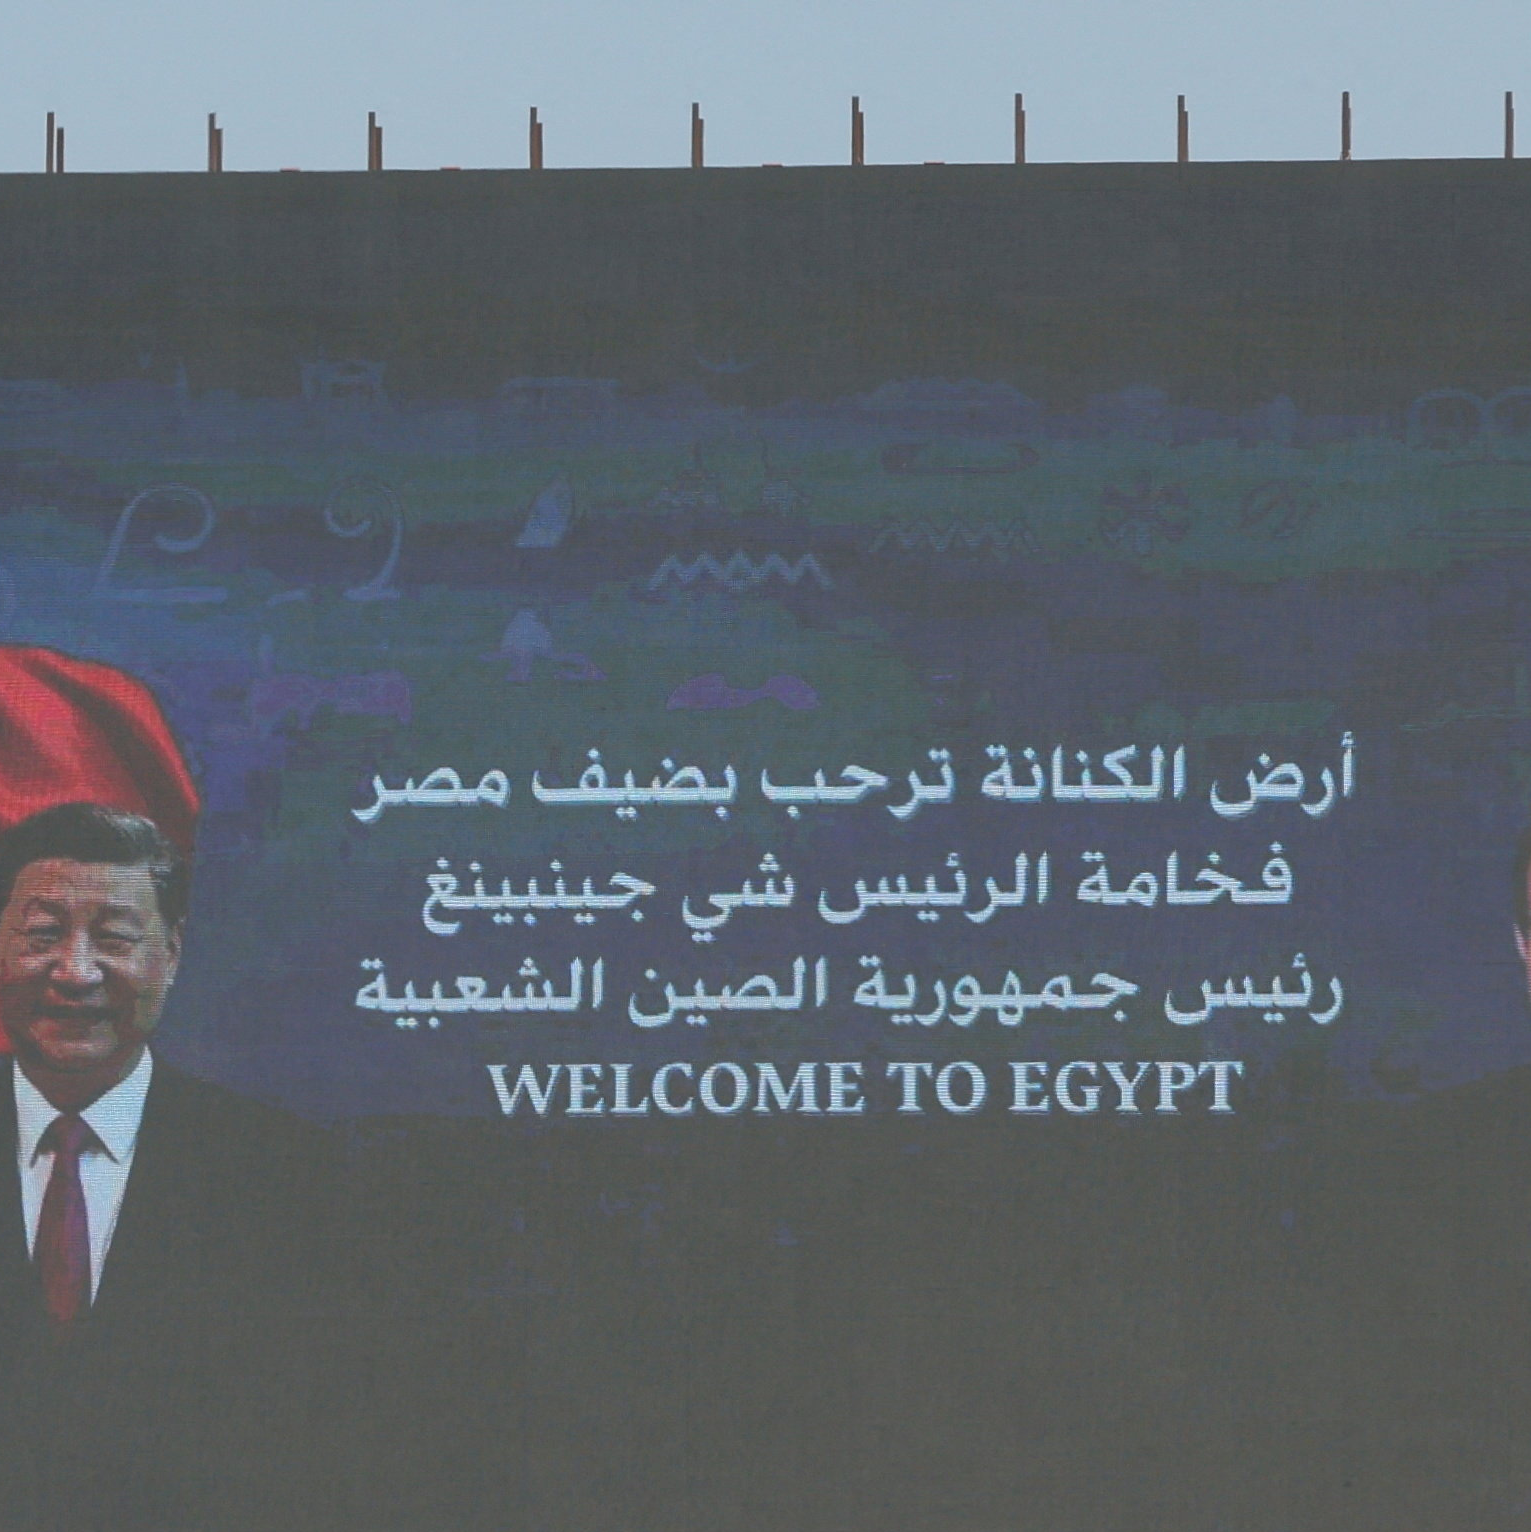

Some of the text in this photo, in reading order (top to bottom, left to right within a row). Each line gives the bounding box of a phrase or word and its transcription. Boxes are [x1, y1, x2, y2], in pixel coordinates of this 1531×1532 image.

[352, 730, 1355, 823] أرض الكنانة ترحب بضيف مصر
[422, 841, 1293, 943] فخامة الرئيس شي جينبينغ
[355, 952, 1343, 1029] رئيس جمهورية الصين الشعبية
[487, 1060, 1244, 1115] WELCOME TO EGYPT
